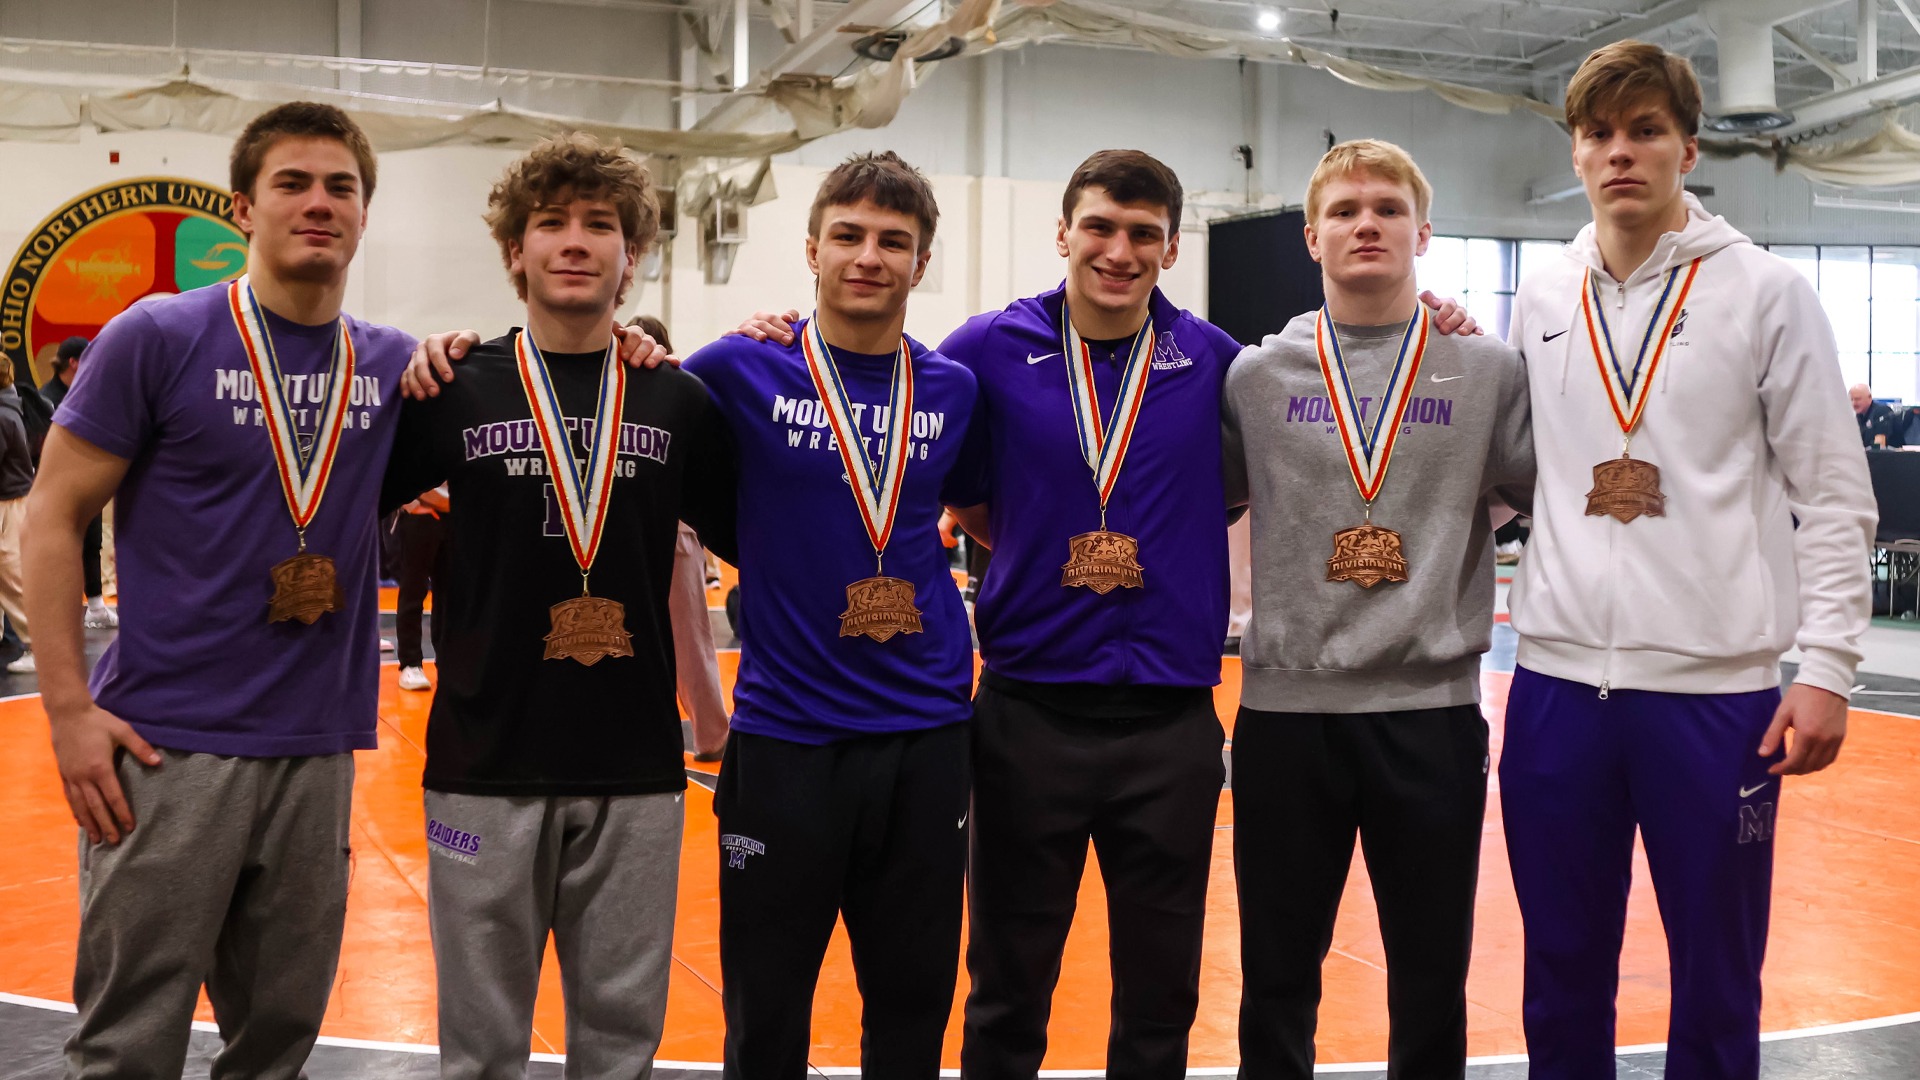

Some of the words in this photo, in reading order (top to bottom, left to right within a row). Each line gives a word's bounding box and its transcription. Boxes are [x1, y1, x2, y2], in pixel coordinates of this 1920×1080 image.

[2, 278, 30, 350] OHIO
[20, 182, 158, 276] NORTHERN
[167, 183, 235, 217] UNIV
[1152, 357, 1193, 370] WRESTLING
[308, 373, 382, 407] UON
[233, 406, 371, 430] WRTNG
[772, 394, 867, 430] MOUT
[872, 404, 945, 441] UON
[1286, 396, 1373, 423] MOUT
[787, 429, 928, 461] WRETLNG
[503, 457, 637, 479] WRTNG
[427, 818, 481, 852] RAIDERS
[1738, 801, 1773, 844] M
[721, 833, 741, 847] OUNT
[741, 836, 766, 855] UNION
[728, 850, 747, 870] M
